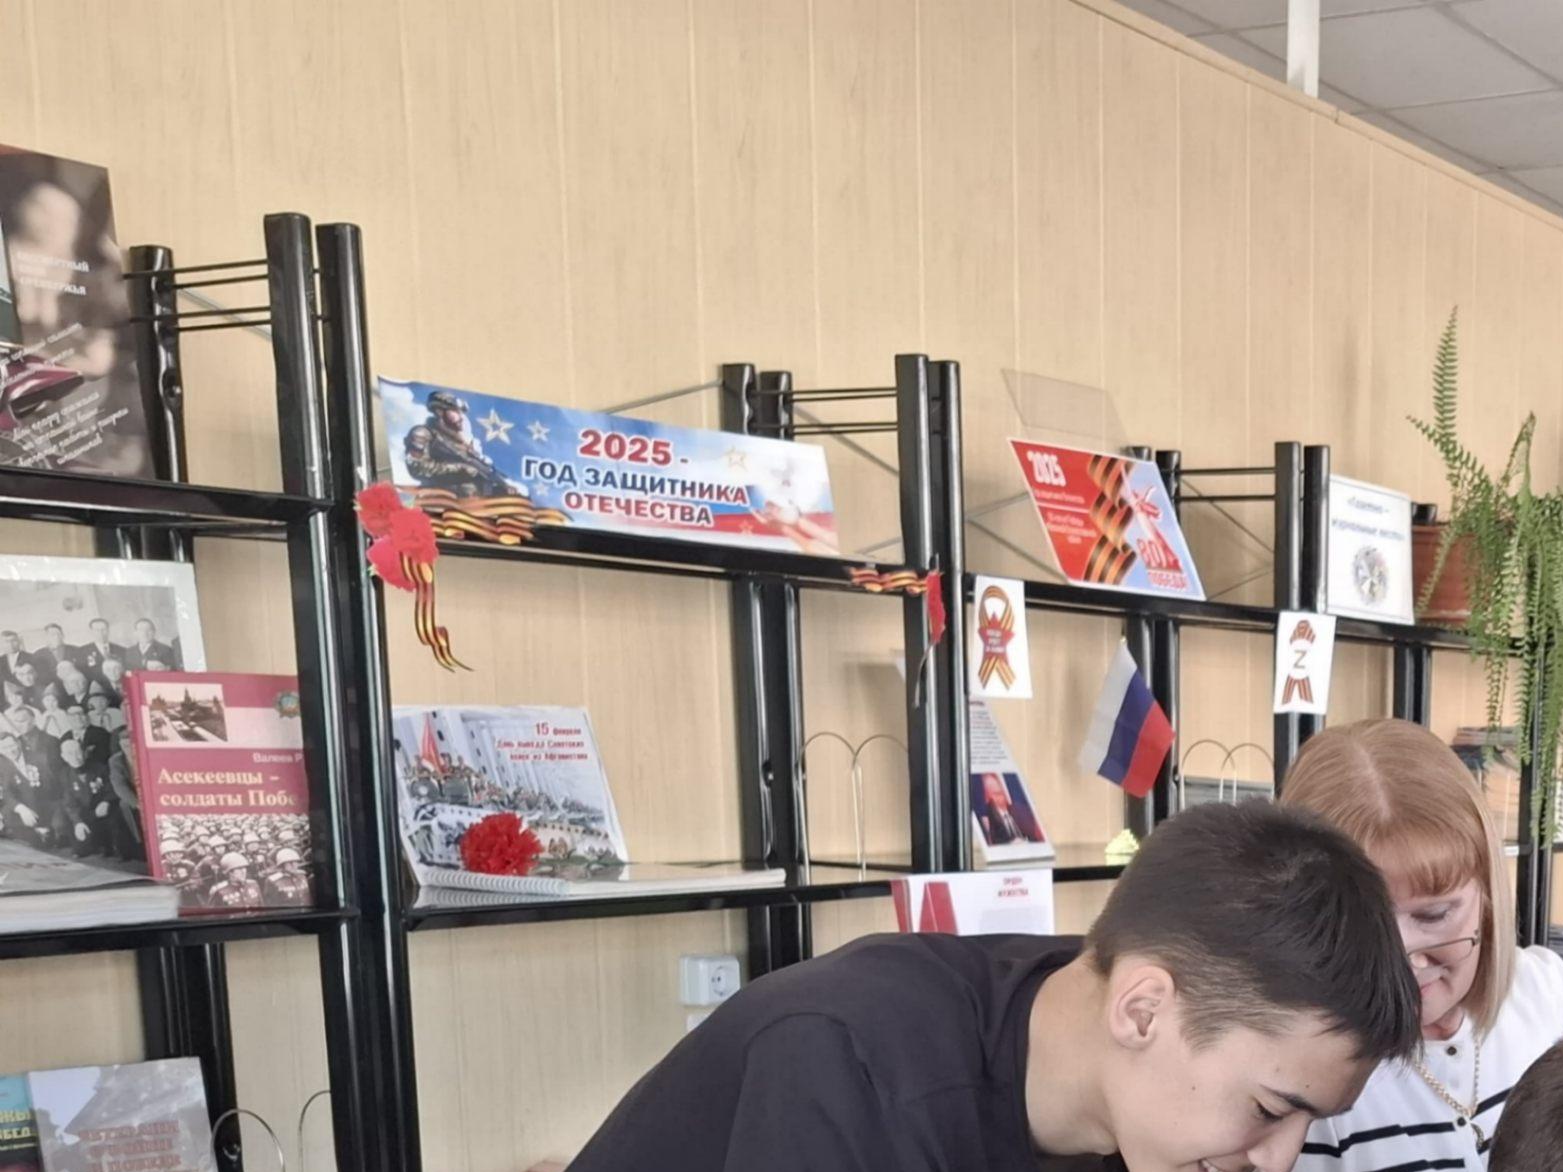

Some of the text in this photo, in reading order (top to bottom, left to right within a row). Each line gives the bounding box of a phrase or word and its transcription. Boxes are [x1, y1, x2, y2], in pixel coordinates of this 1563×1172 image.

[579, 429, 672, 466] 2025
[524, 458, 748, 504] ГОД ЗАЩИТНИКА
[1026, 450, 1067, 487] 2025
[564, 491, 712, 525] ОТЕЧЕСТВА
[1293, 649, 1307, 669] Z
[536, 722, 549, 735] 15
[158, 768, 263, 785] Асекеевцы
[159, 793, 243, 806] солдаты
